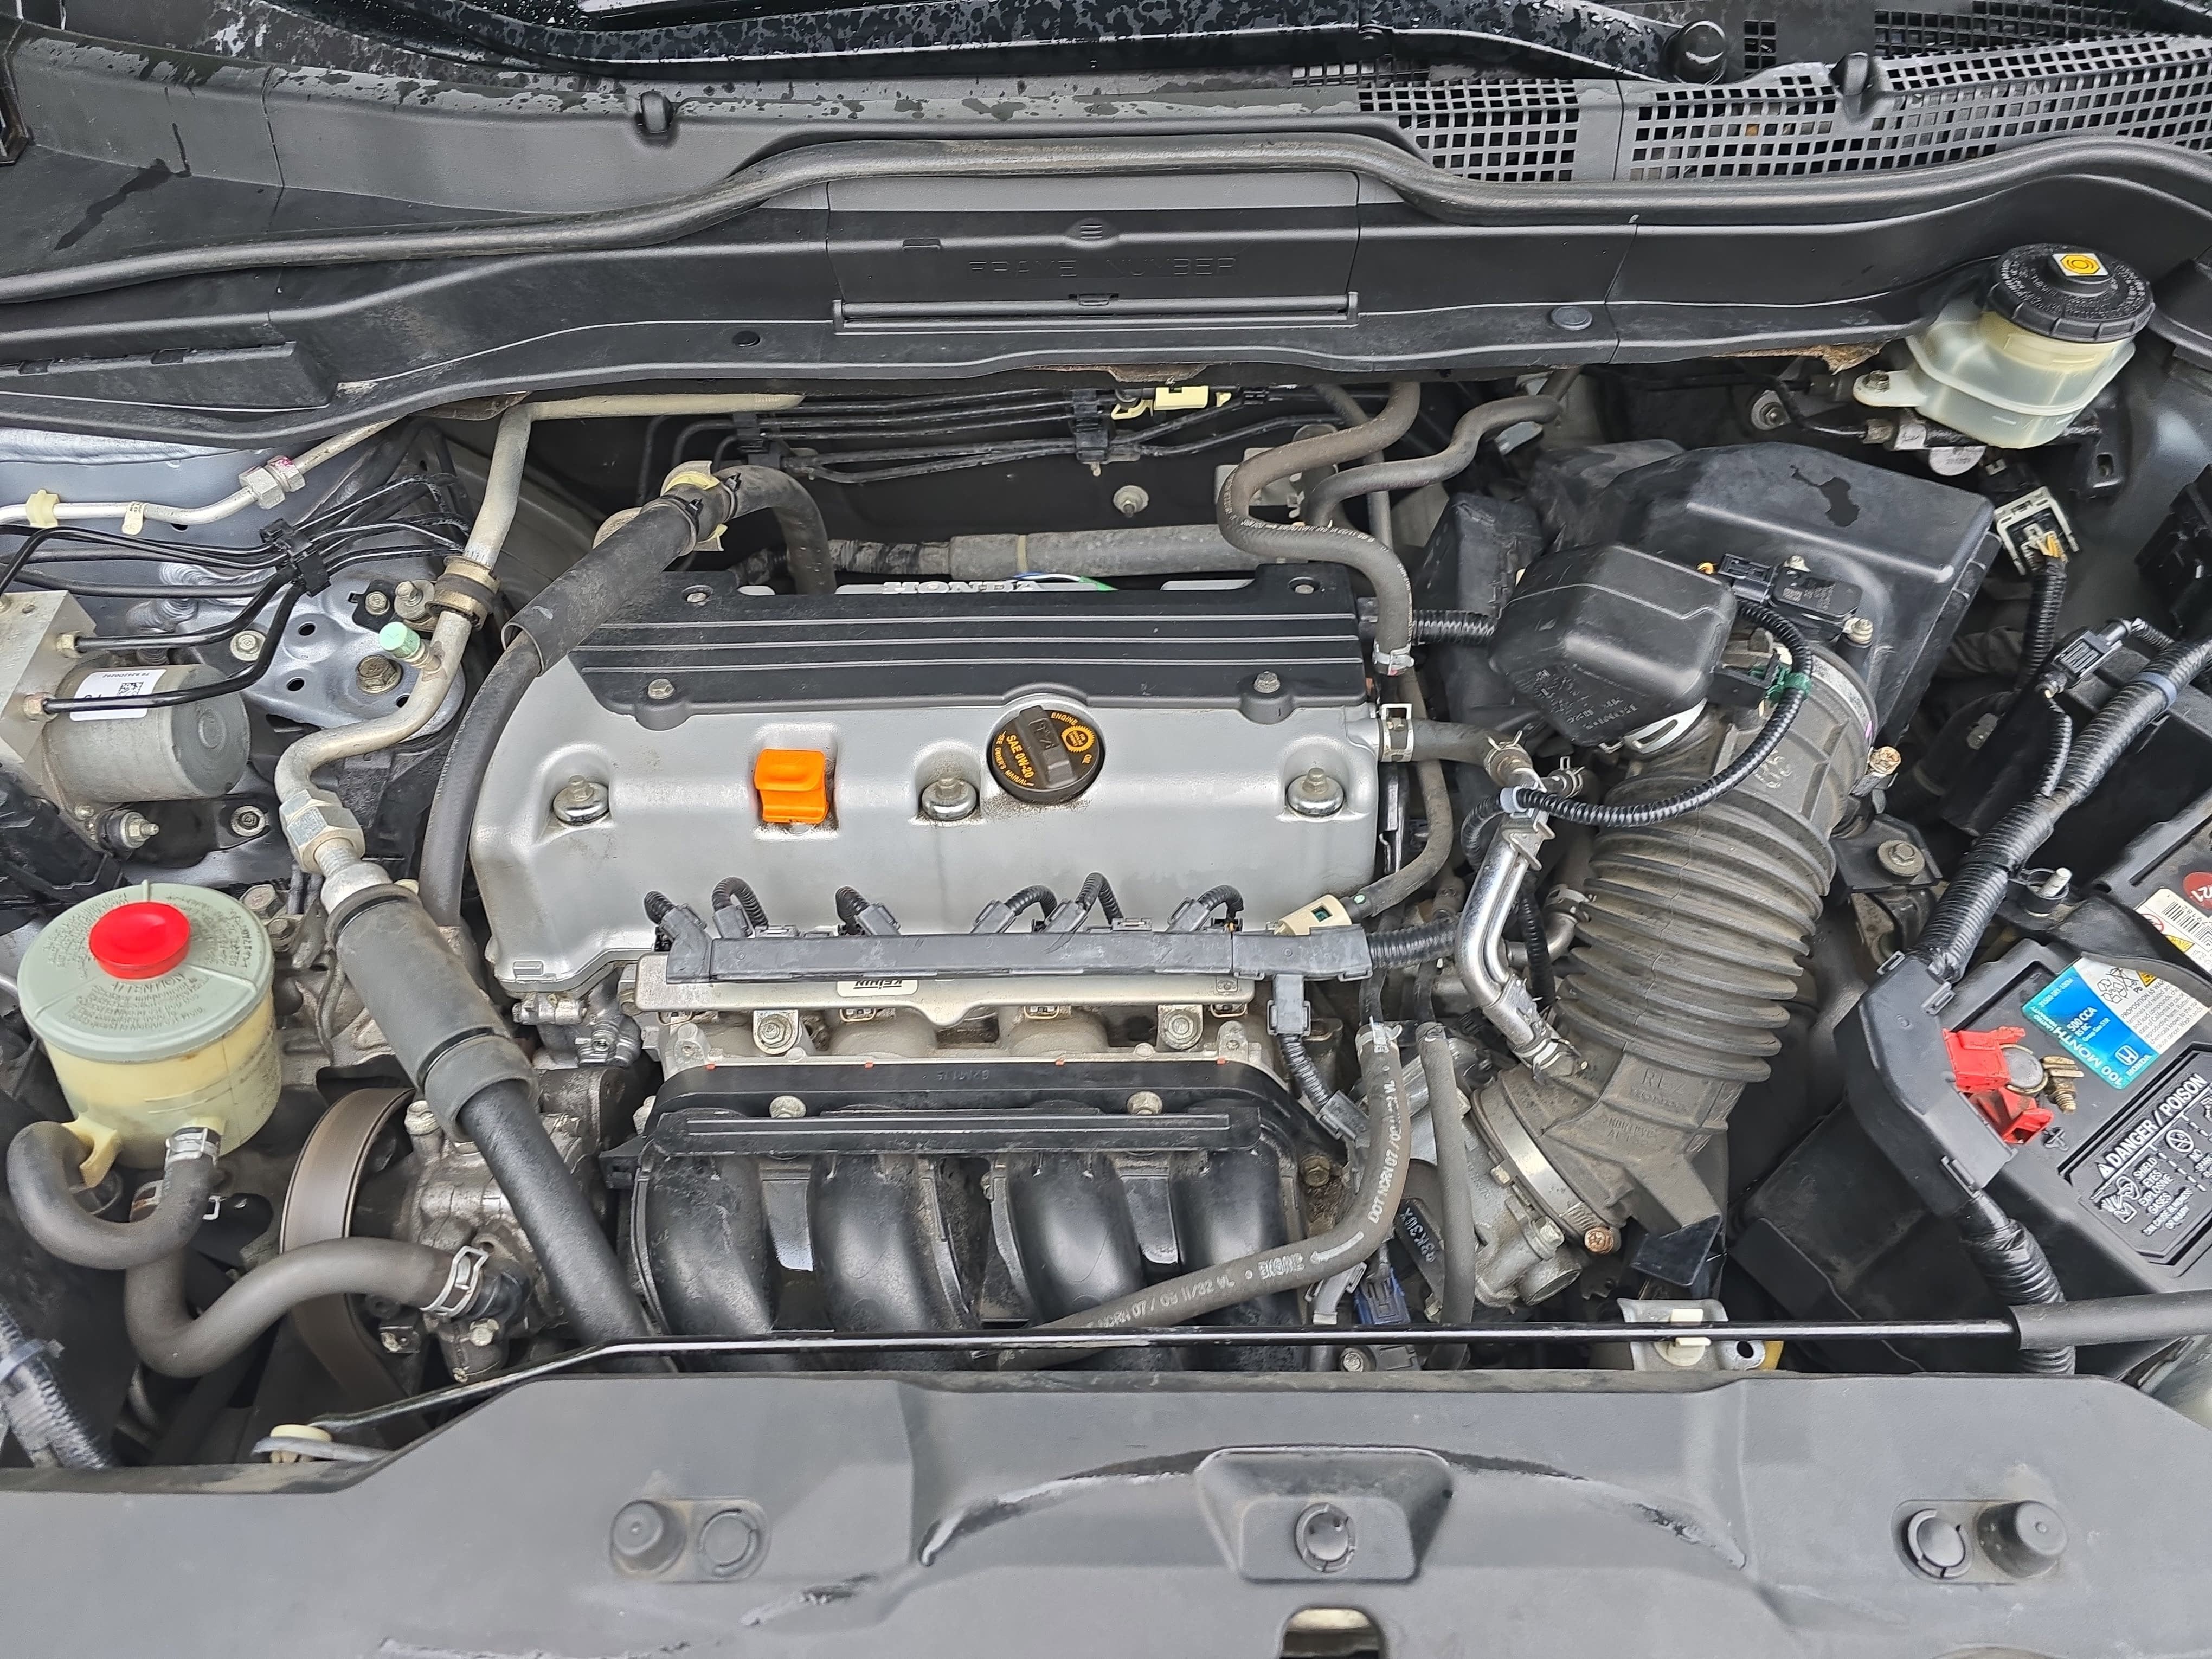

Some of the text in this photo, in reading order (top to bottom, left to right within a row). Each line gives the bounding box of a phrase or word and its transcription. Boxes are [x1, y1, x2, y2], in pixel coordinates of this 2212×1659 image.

[881, 581, 1043, 594] HONDA
[1006, 735, 1021, 754] SAE
[1051, 712, 1092, 764] ENGINE OIL
[995, 748, 1006, 770] OWNER'S
[1004, 770, 1027, 786] MANUAL
[111, 973, 185, 993] ATTENTION
[2133, 986, 2143, 994] Pb
[2120, 993, 2150, 1019] PROPOSITION
[2126, 1006, 2145, 1025] terminals
[2143, 1000, 2153, 1009] and
[2150, 989, 2165, 1003] related
[2067, 1007, 2098, 1031] 500 CCA
[2082, 1023, 2092, 1032] RC
[2132, 1020, 2142, 1030] and
[2139, 1012, 2151, 1024] lead
[2138, 1024, 2150, 1036] state
[2150, 1004, 2170, 1023] California
[2144, 1016, 2169, 1041] reproductive
[2149, 1025, 2169, 1045] chemicals
[2166, 1015, 2181, 1029] known
[2183, 1005, 2192, 1014] the
[2178, 1016, 2191, 1028] Wash
[2053, 1025, 2123, 1085] 100 MONTH
[2126, 1054, 2152, 1077] HONDA
[2105, 1073, 2208, 1168] DANGER / POISON
[2189, 1149, 2203, 1162] NO
[2133, 1156, 2158, 1180] SHIELD
[2142, 1169, 2163, 1188] EYES
[1366, 1195, 1386, 1224] DOT
[1384, 1148, 1400, 1167] 07
[2138, 1173, 2174, 1207] EXPLOSIVE
[2147, 1192, 2171, 1214] GASES
